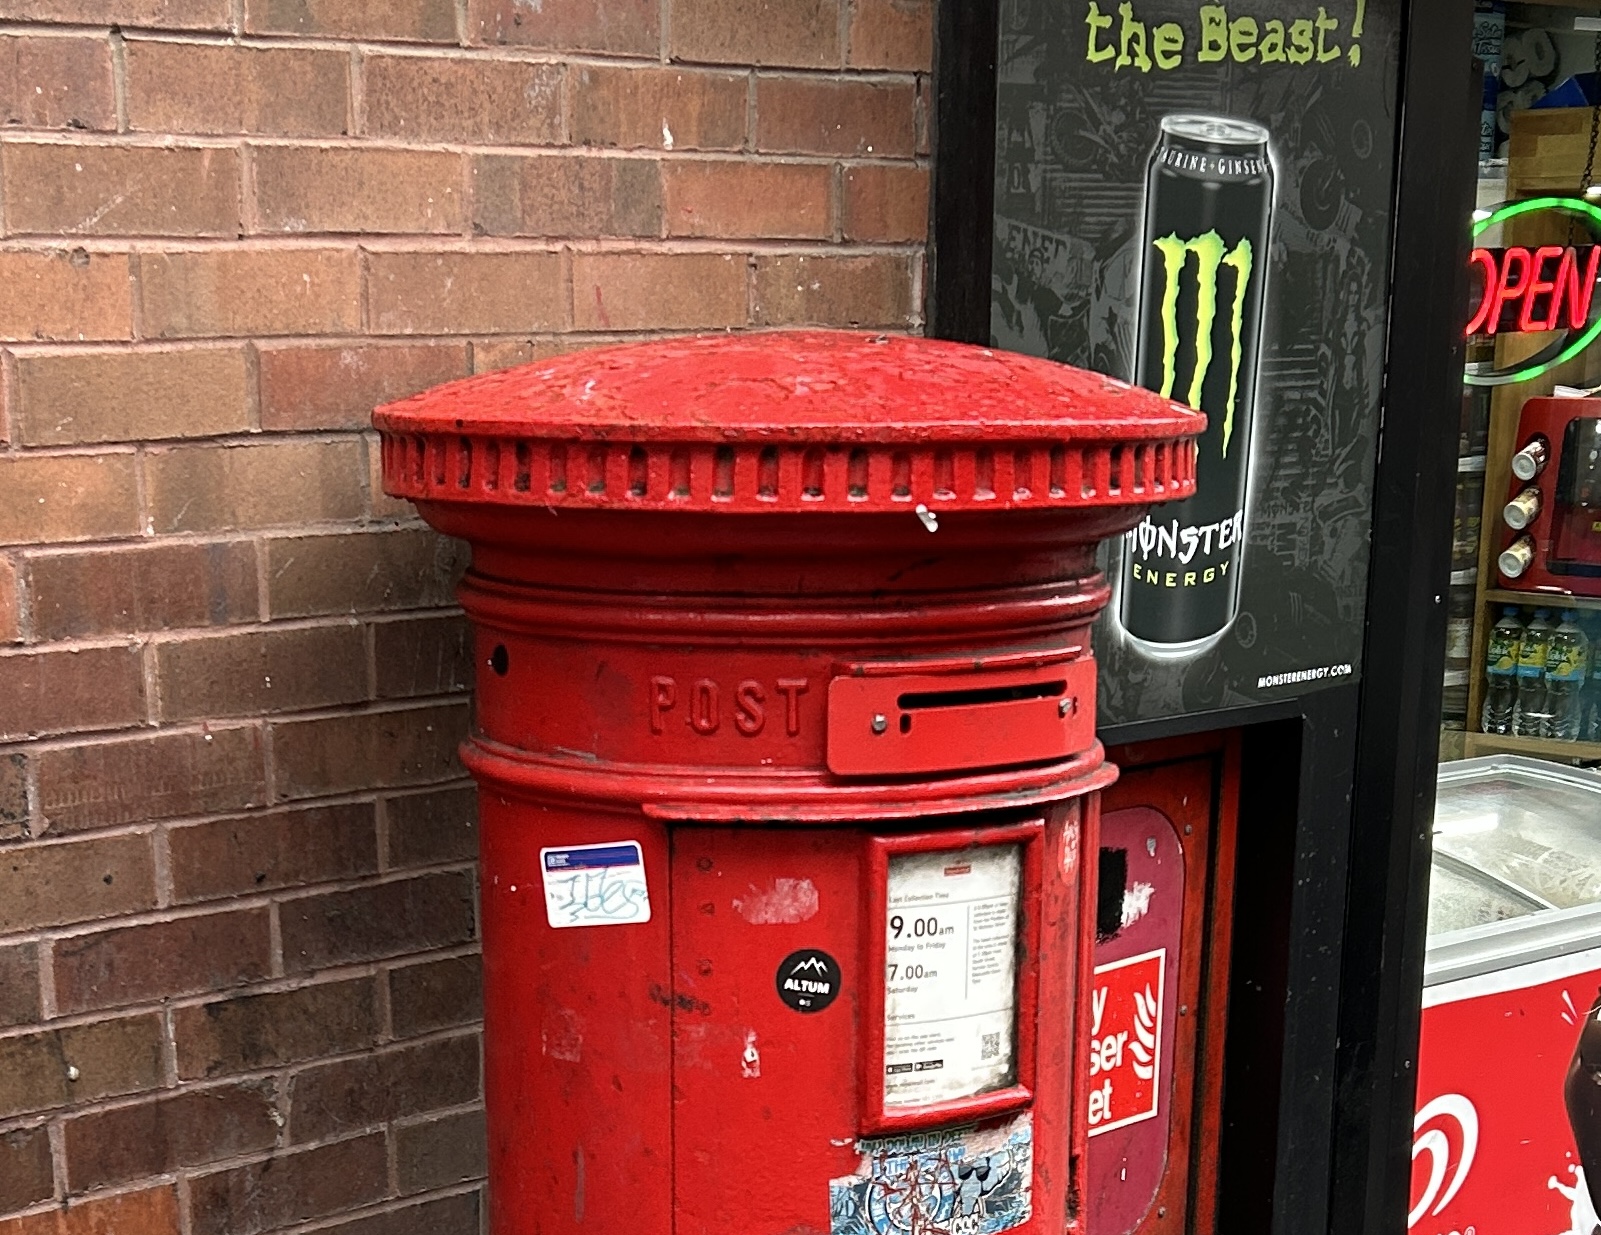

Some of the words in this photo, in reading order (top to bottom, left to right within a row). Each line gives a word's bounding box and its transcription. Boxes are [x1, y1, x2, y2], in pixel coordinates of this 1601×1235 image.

[1085, 2, 1184, 72] the
[1198, 0, 1366, 67] Beast!
[1466, 246, 1601, 335] OPEN
[1133, 561, 1229, 587] ENERGY
[1257, 664, 1352, 689] MONSTERENERGY.COM
[651, 675, 809, 737] POST
[925, 942, 946, 950] Friday
[784, 978, 830, 994] ALTUM
[886, 985, 919, 995] Saturday
[1091, 986, 1108, 1036] y
[1089, 1030, 1128, 1076] ser
[1087, 1078, 1113, 1125] et
